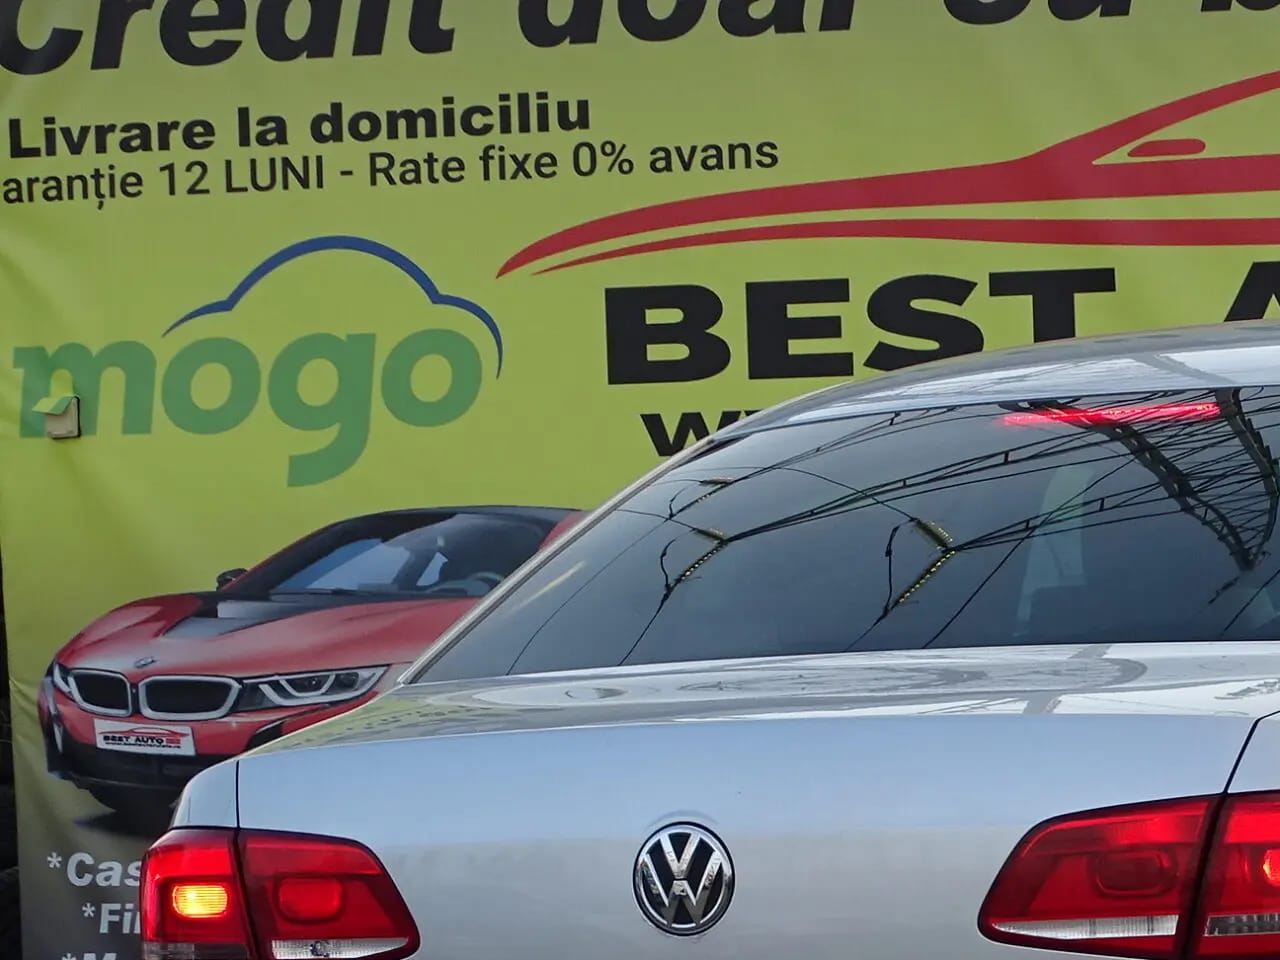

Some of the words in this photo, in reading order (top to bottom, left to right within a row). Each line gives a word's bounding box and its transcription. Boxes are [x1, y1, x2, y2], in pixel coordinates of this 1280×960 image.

[8, 116, 216, 159] Livrare
[237, 107, 289, 148] la
[310, 92, 591, 144] domiciliu
[2, 164, 144, 210] aranție
[159, 162, 211, 196] 12
[225, 155, 325, 193] LUNI
[369, 152, 466, 187] Rate
[479, 144, 558, 182] fixe
[573, 140, 635, 177] 0%
[649, 140, 780, 173] avans
[604, 267, 1117, 385] BEST
[13, 327, 484, 488] mogo
[47, 852, 142, 887] Cas
